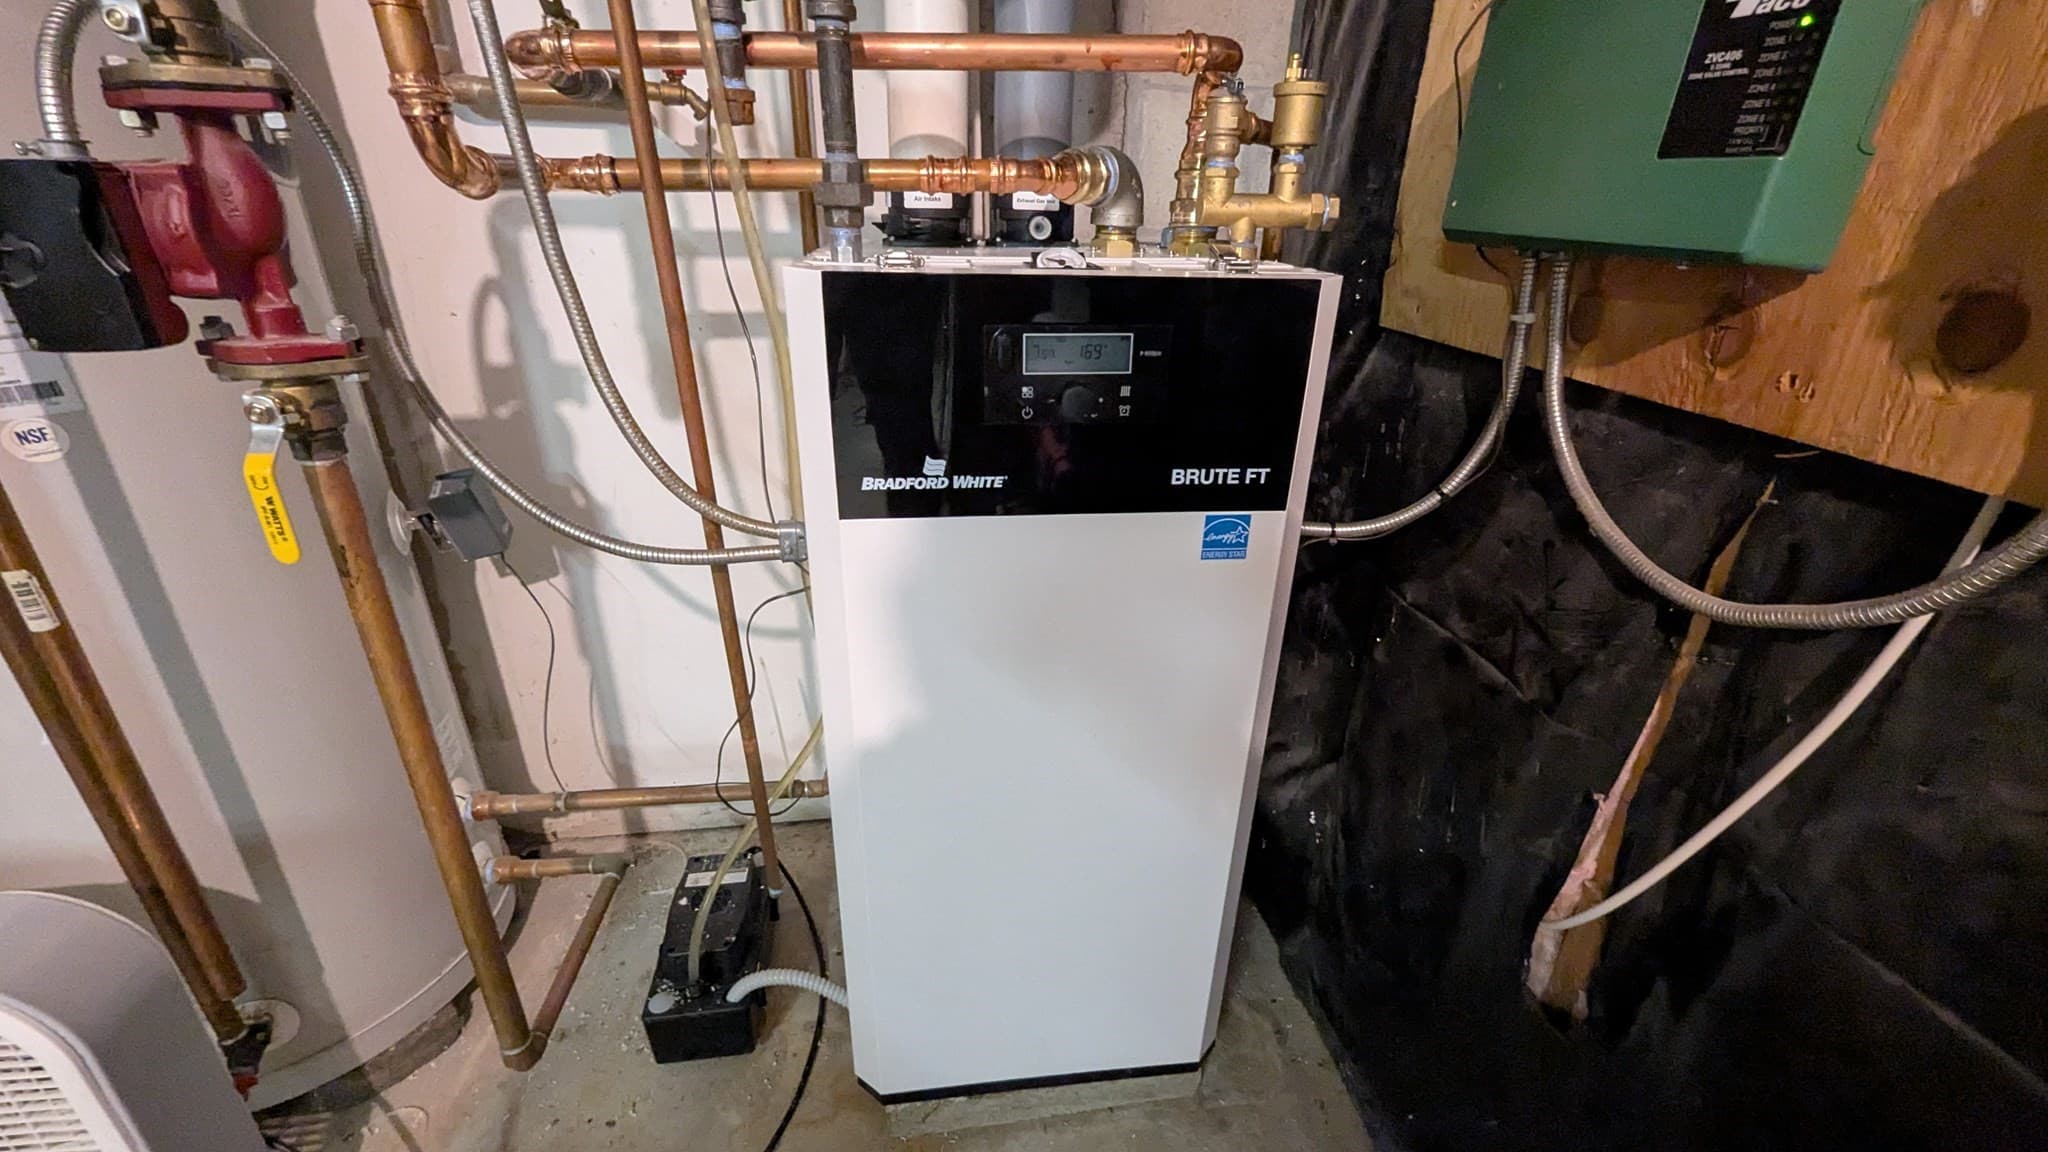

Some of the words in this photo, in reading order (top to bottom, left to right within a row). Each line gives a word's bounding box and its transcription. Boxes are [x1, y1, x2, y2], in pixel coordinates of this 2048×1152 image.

[14, 427, 49, 446] NSF
[861, 477, 949, 490] BRADFORD
[1171, 468, 1241, 485] BRUTE
[1245, 468, 1271, 485] FT
[1202, 551, 1228, 559] ENERGY
[1228, 550, 1246, 558] STAR
